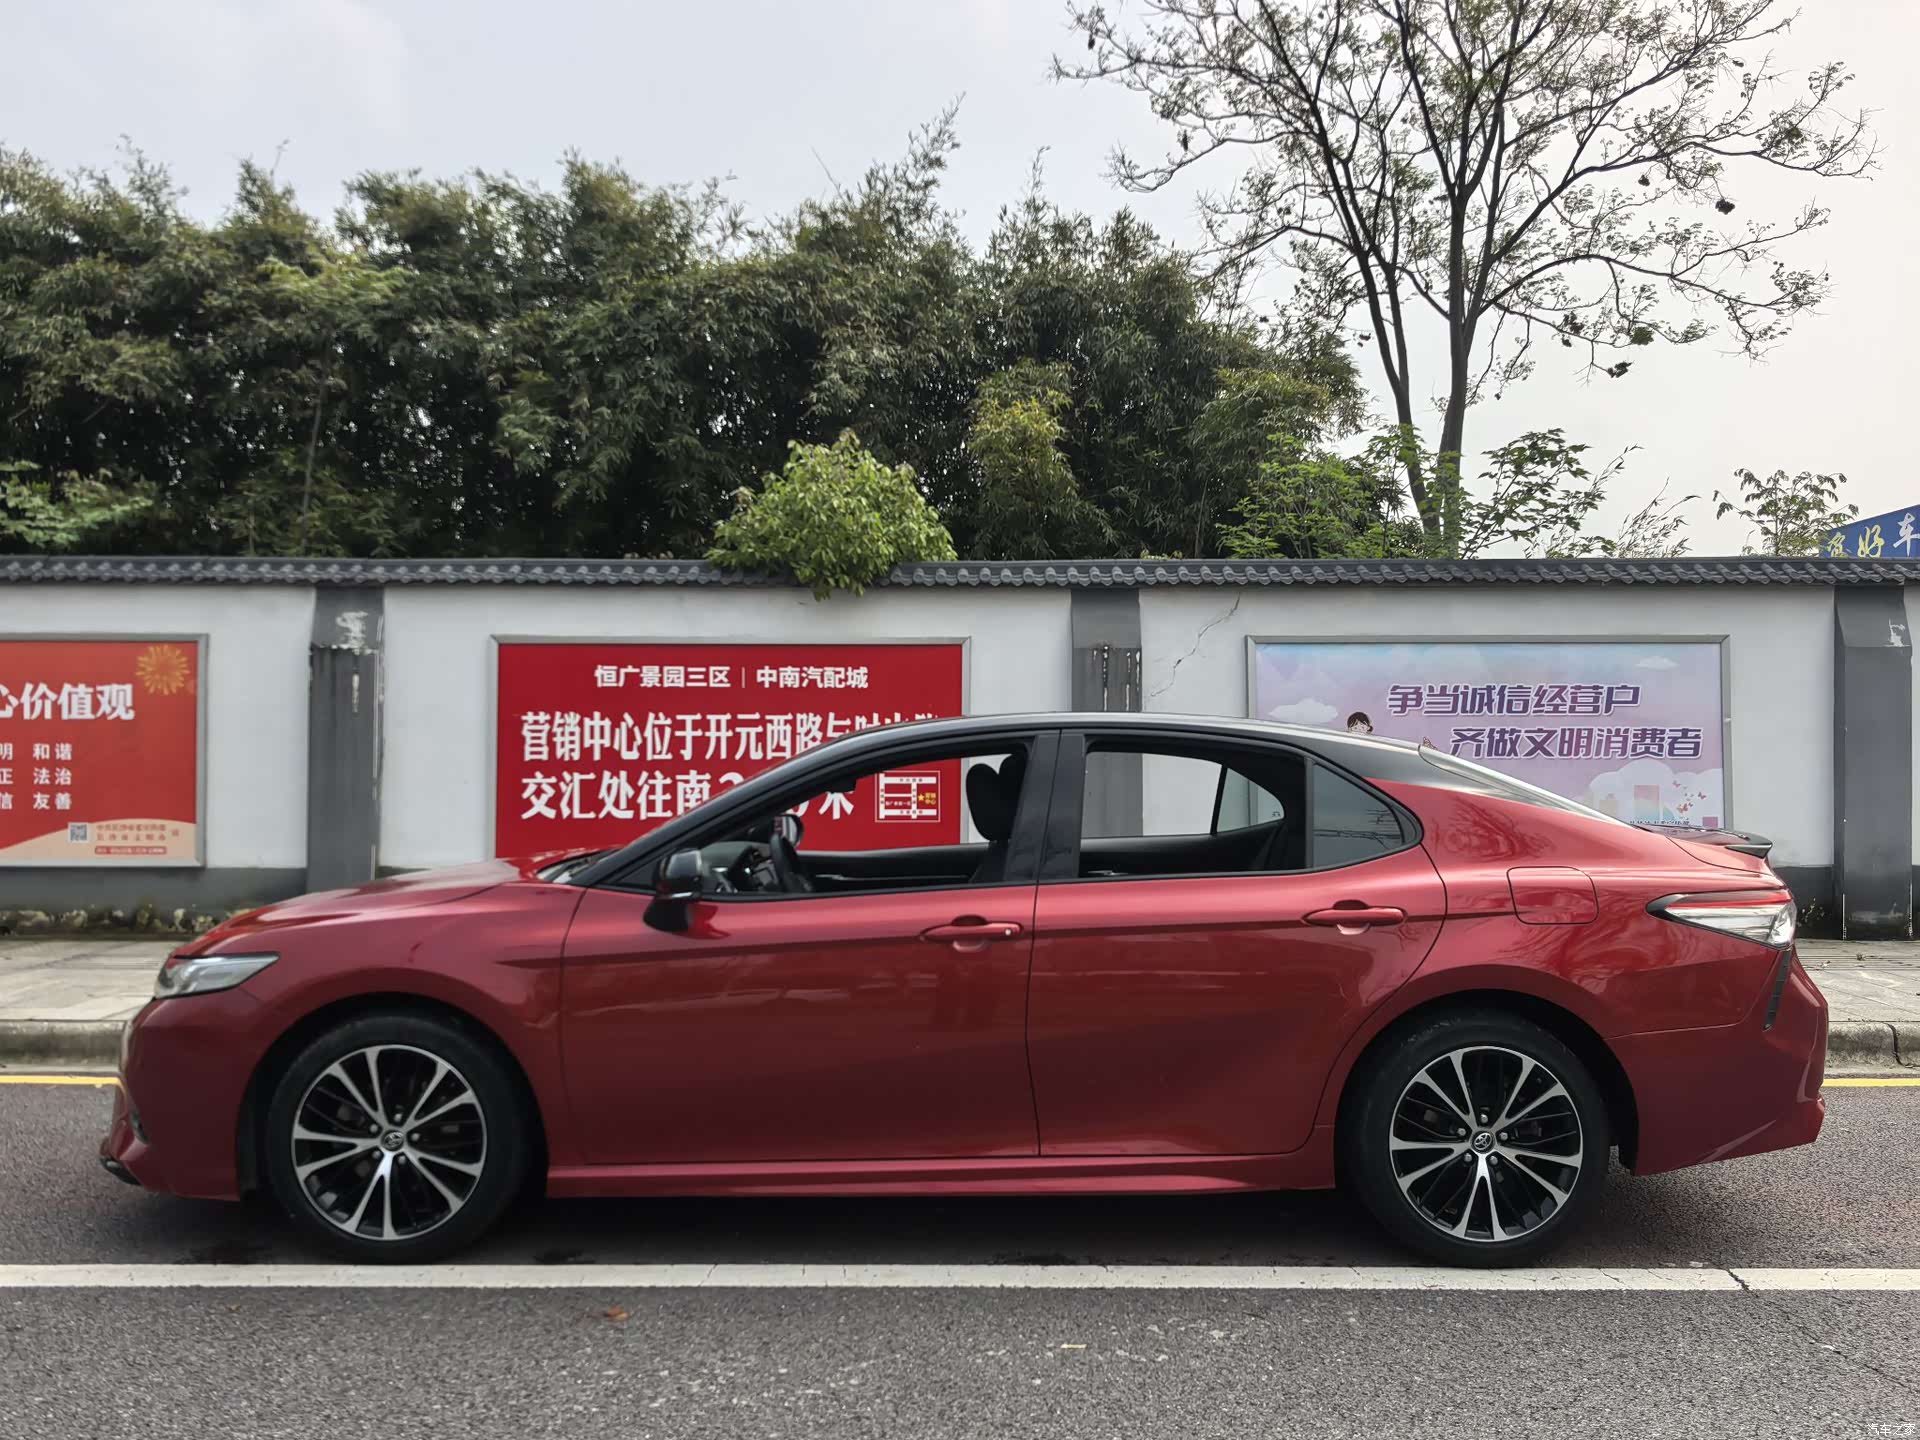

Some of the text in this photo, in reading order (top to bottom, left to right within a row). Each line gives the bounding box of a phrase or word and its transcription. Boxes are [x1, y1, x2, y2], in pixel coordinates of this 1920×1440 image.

[595, 665, 869, 689] 恒广景园三区 中南汽配城
[1388, 683, 1641, 716] 争当诚信经营户
[521, 711, 938, 761] 营销中心位于开元西路与
[1450, 726, 1703, 759] 齐做文明消费者
[33, 743, 72, 760] 和谐
[33, 767, 72, 785] 法治
[33, 792, 72, 810] 友善
